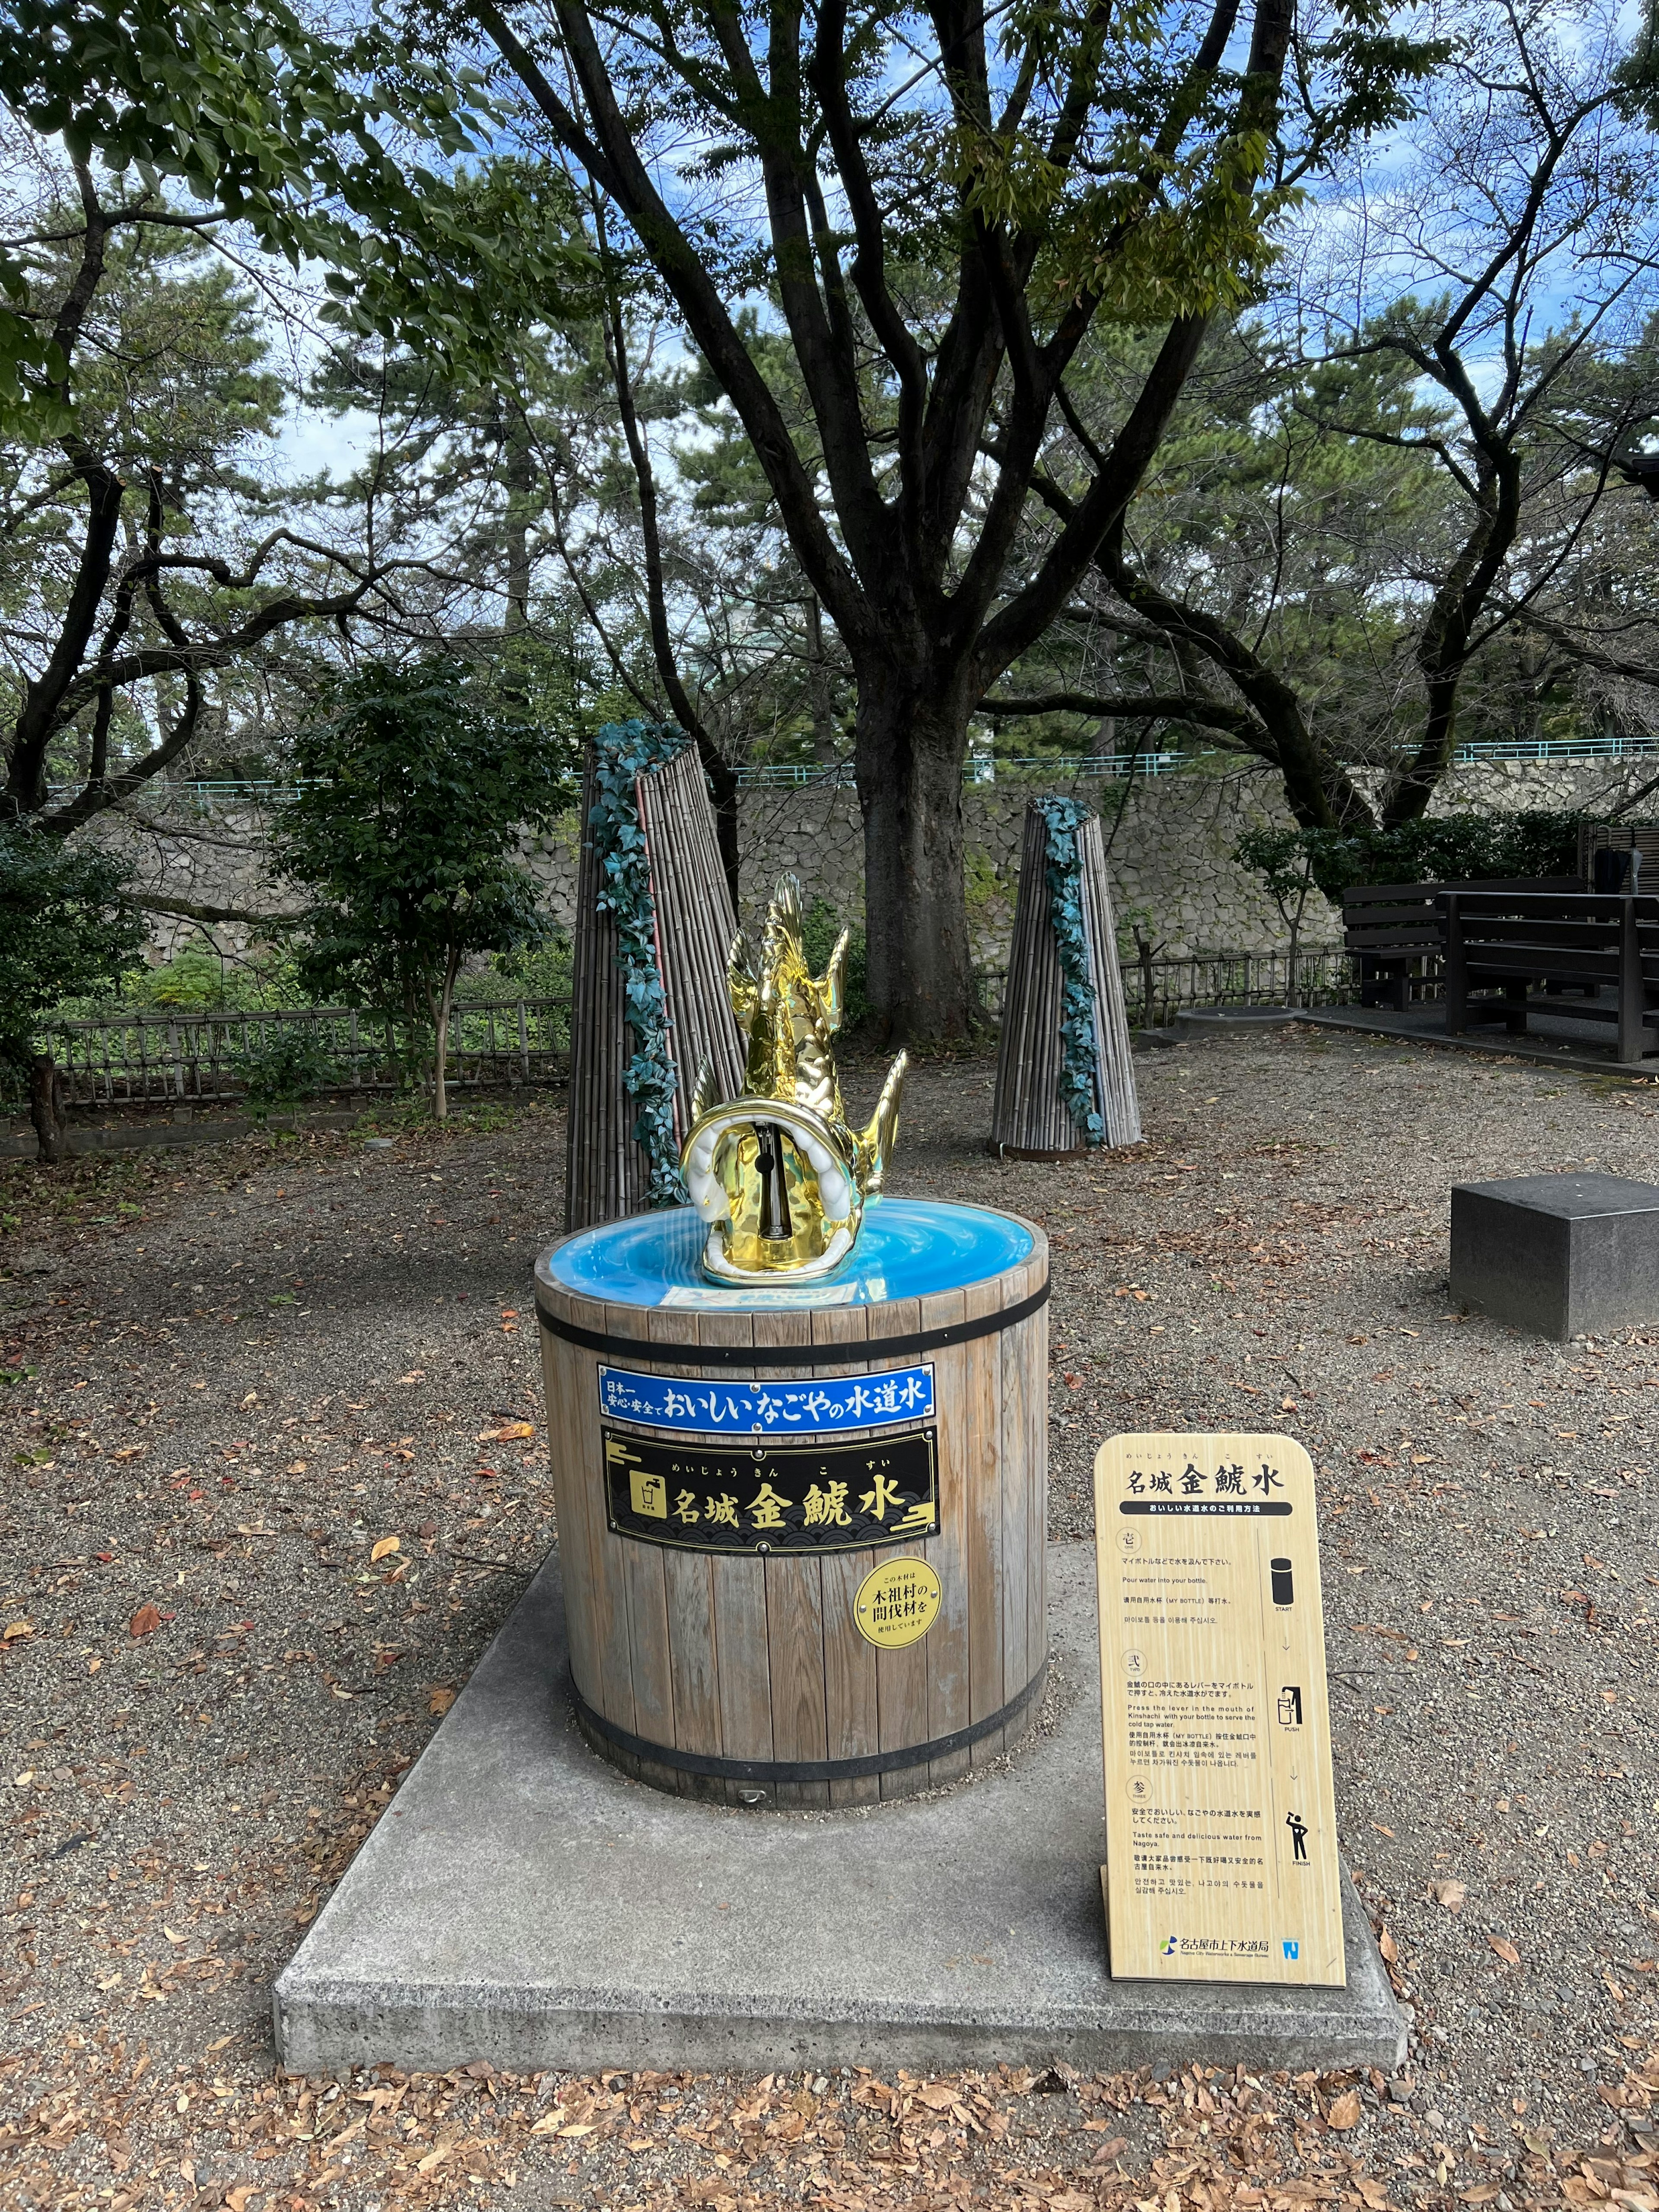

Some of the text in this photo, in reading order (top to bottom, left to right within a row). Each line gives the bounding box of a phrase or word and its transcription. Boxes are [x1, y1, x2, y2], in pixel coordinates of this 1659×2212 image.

[607, 1381, 636, 1395] 日本一
[672, 1459, 890, 1477] めいじょう きん こ すい
[1149, 1504, 1260, 1513] おいしい水道水のご利用方法
[1123, 1533, 1134, 1545] 壱
[884, 1573, 915, 1583] この木材は
[872, 1583, 928, 1605] 木祖村の
[873, 1600, 927, 1623] 間伐材を
[878, 1619, 922, 1634] 使用しています
[1132, 1808, 1261, 1818] 安全でおいしい、なごやの水道水を実感
[1180, 1938, 1269, 1952] 名古屋市上下水道局
